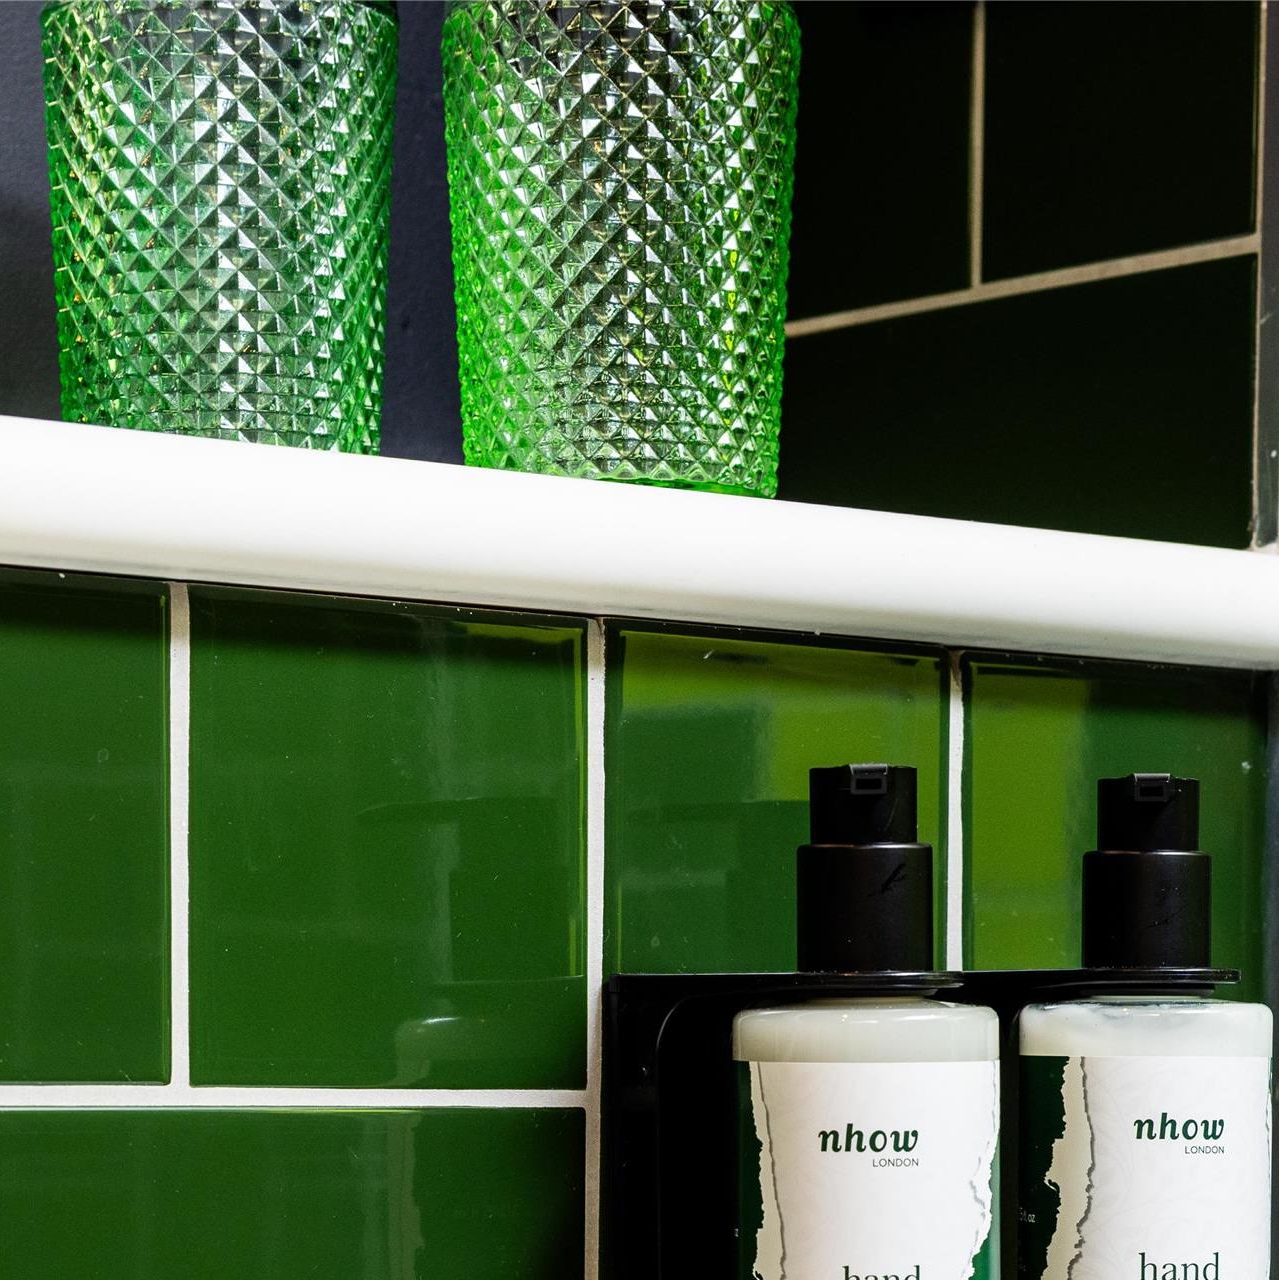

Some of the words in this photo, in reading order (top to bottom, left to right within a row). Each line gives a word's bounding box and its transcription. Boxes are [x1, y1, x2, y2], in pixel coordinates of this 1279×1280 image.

[1133, 1112, 1225, 1141] nhow
[817, 1122, 919, 1153] nhow
[1184, 1145, 1225, 1155] LONDON
[872, 1158, 919, 1168] LONDON
